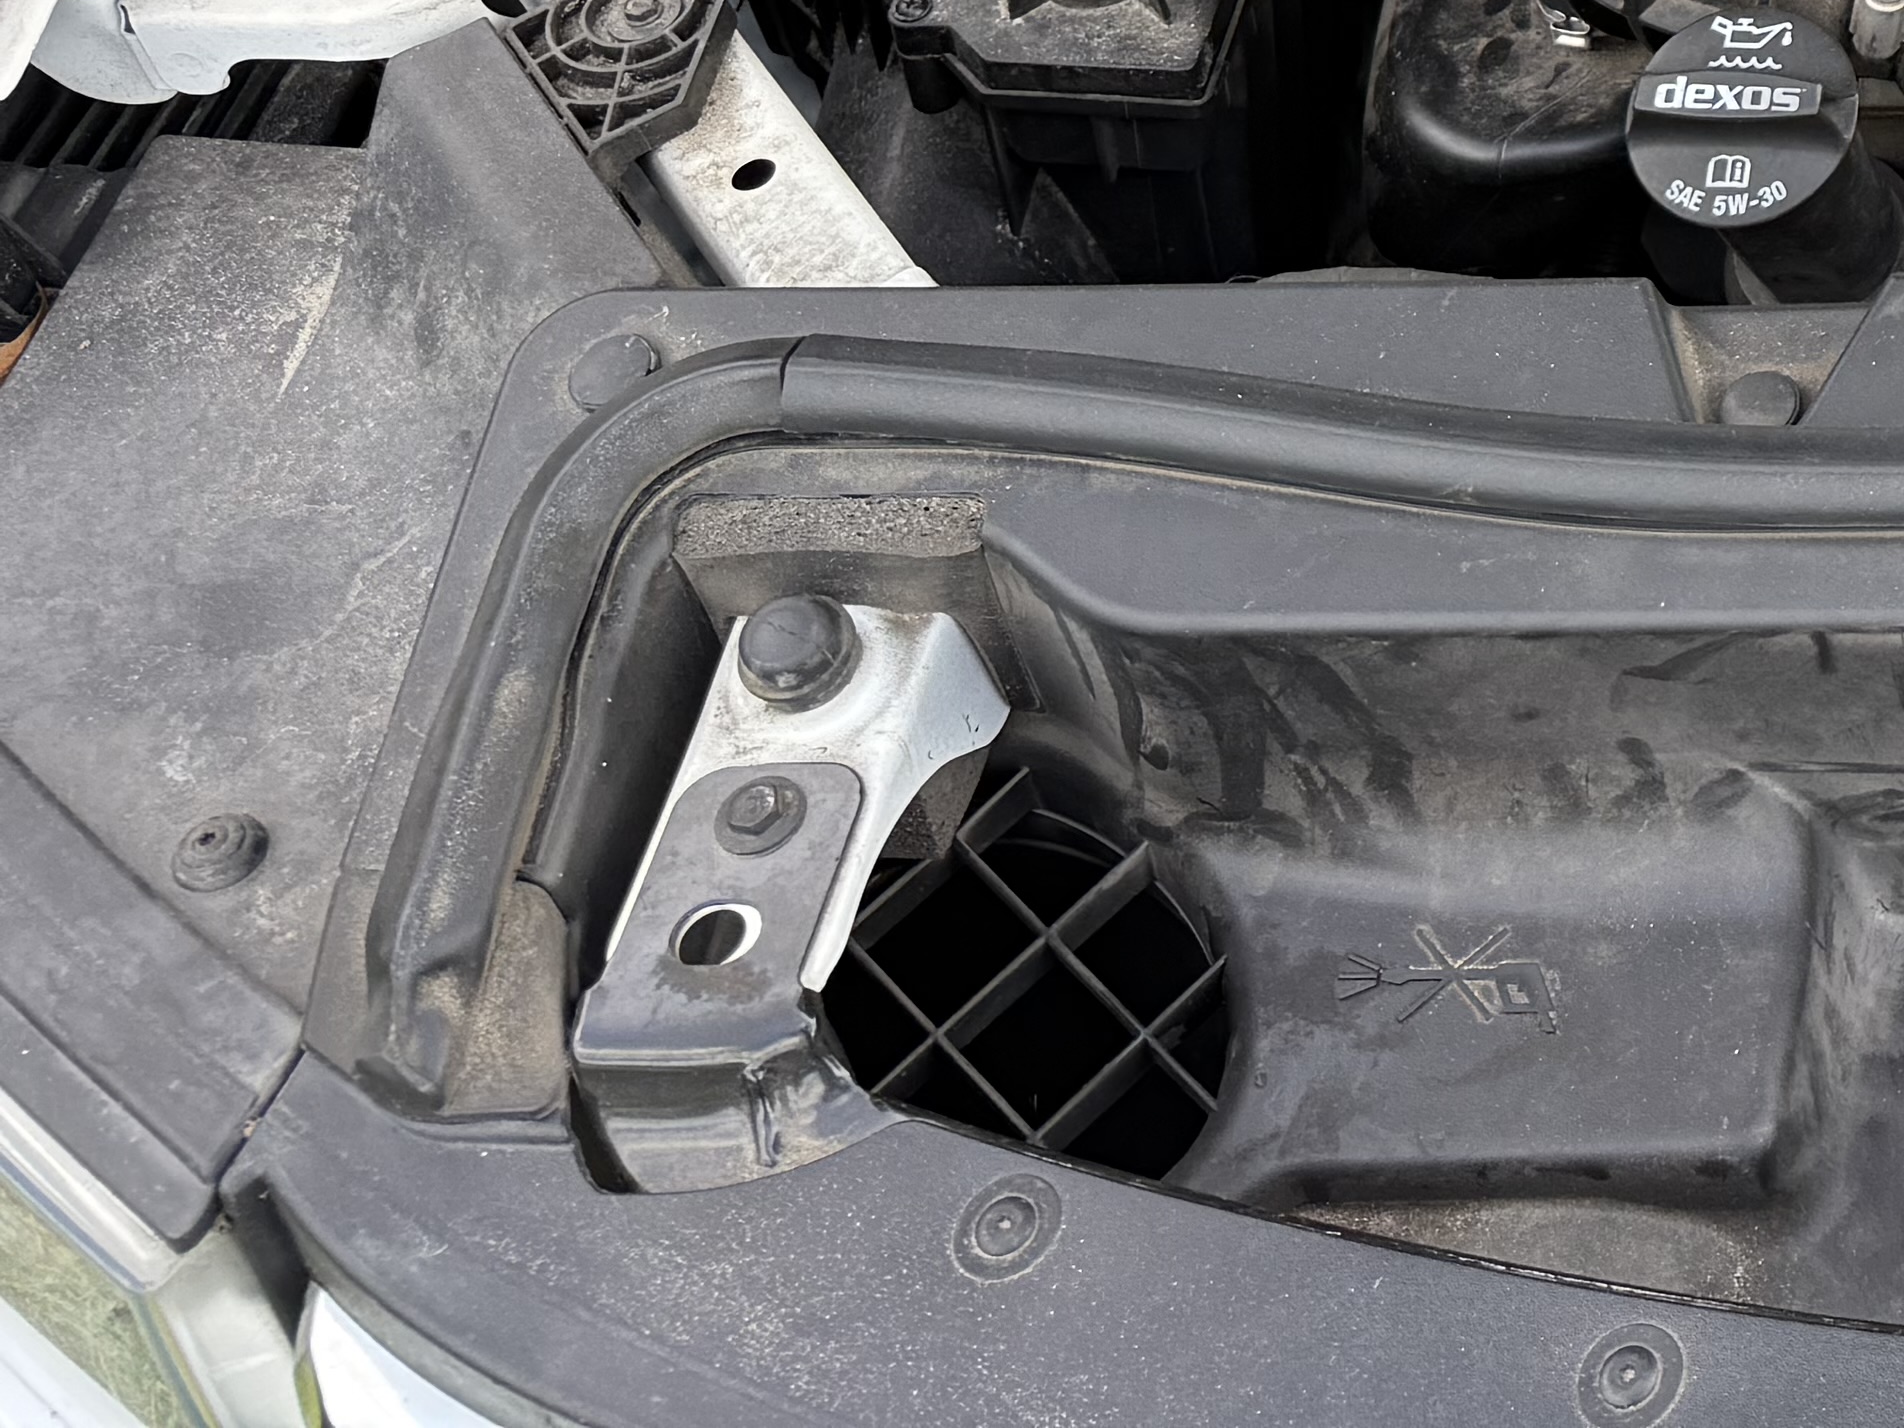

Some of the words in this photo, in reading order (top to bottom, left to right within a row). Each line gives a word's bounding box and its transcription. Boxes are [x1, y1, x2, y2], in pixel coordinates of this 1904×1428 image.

[1654, 76, 1801, 112] dexos
[1665, 179, 1706, 212] SAE
[1712, 180, 1788, 216] 5W-30
